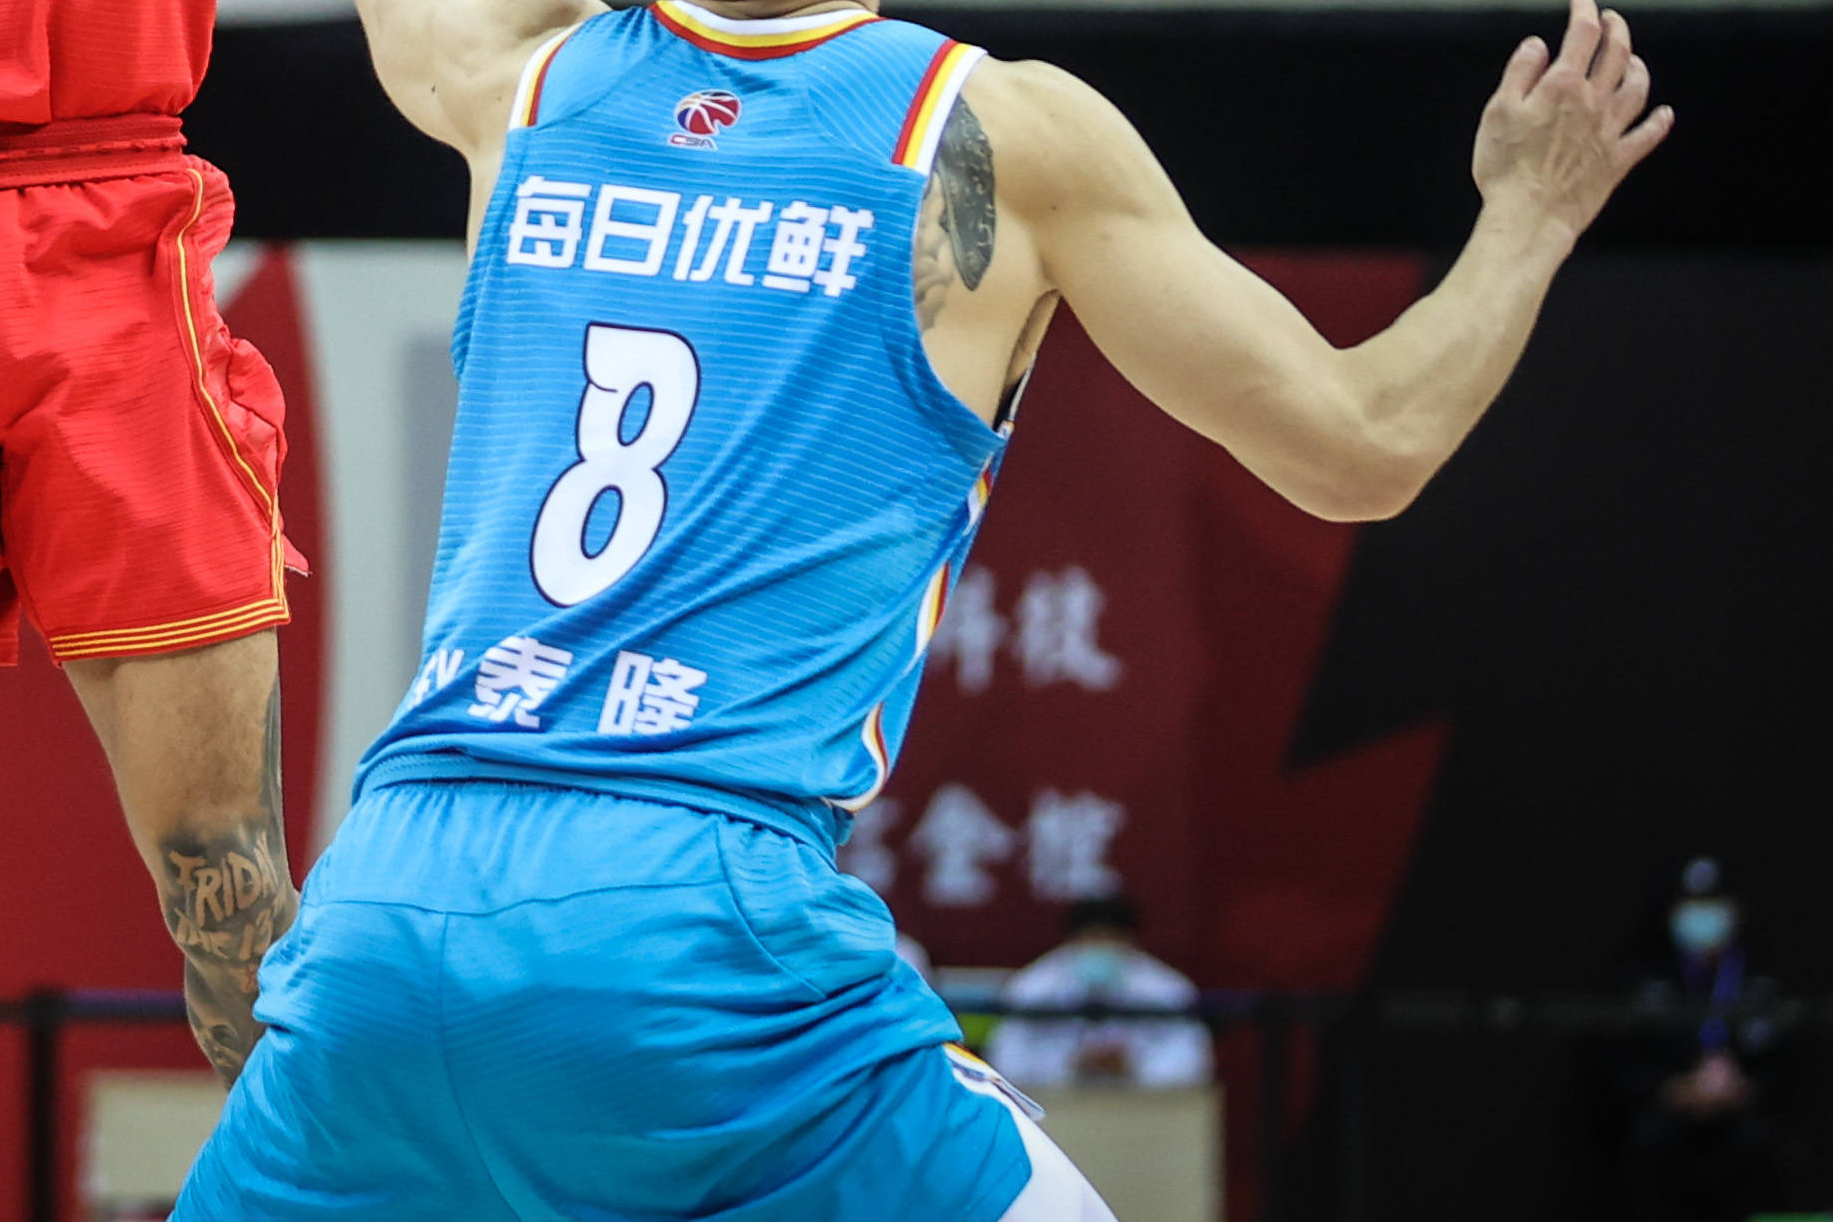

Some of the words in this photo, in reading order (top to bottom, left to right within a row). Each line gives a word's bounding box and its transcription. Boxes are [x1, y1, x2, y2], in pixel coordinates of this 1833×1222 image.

[504, 175, 875, 297] 每日优鲜
[528, 320, 702, 609] 8
